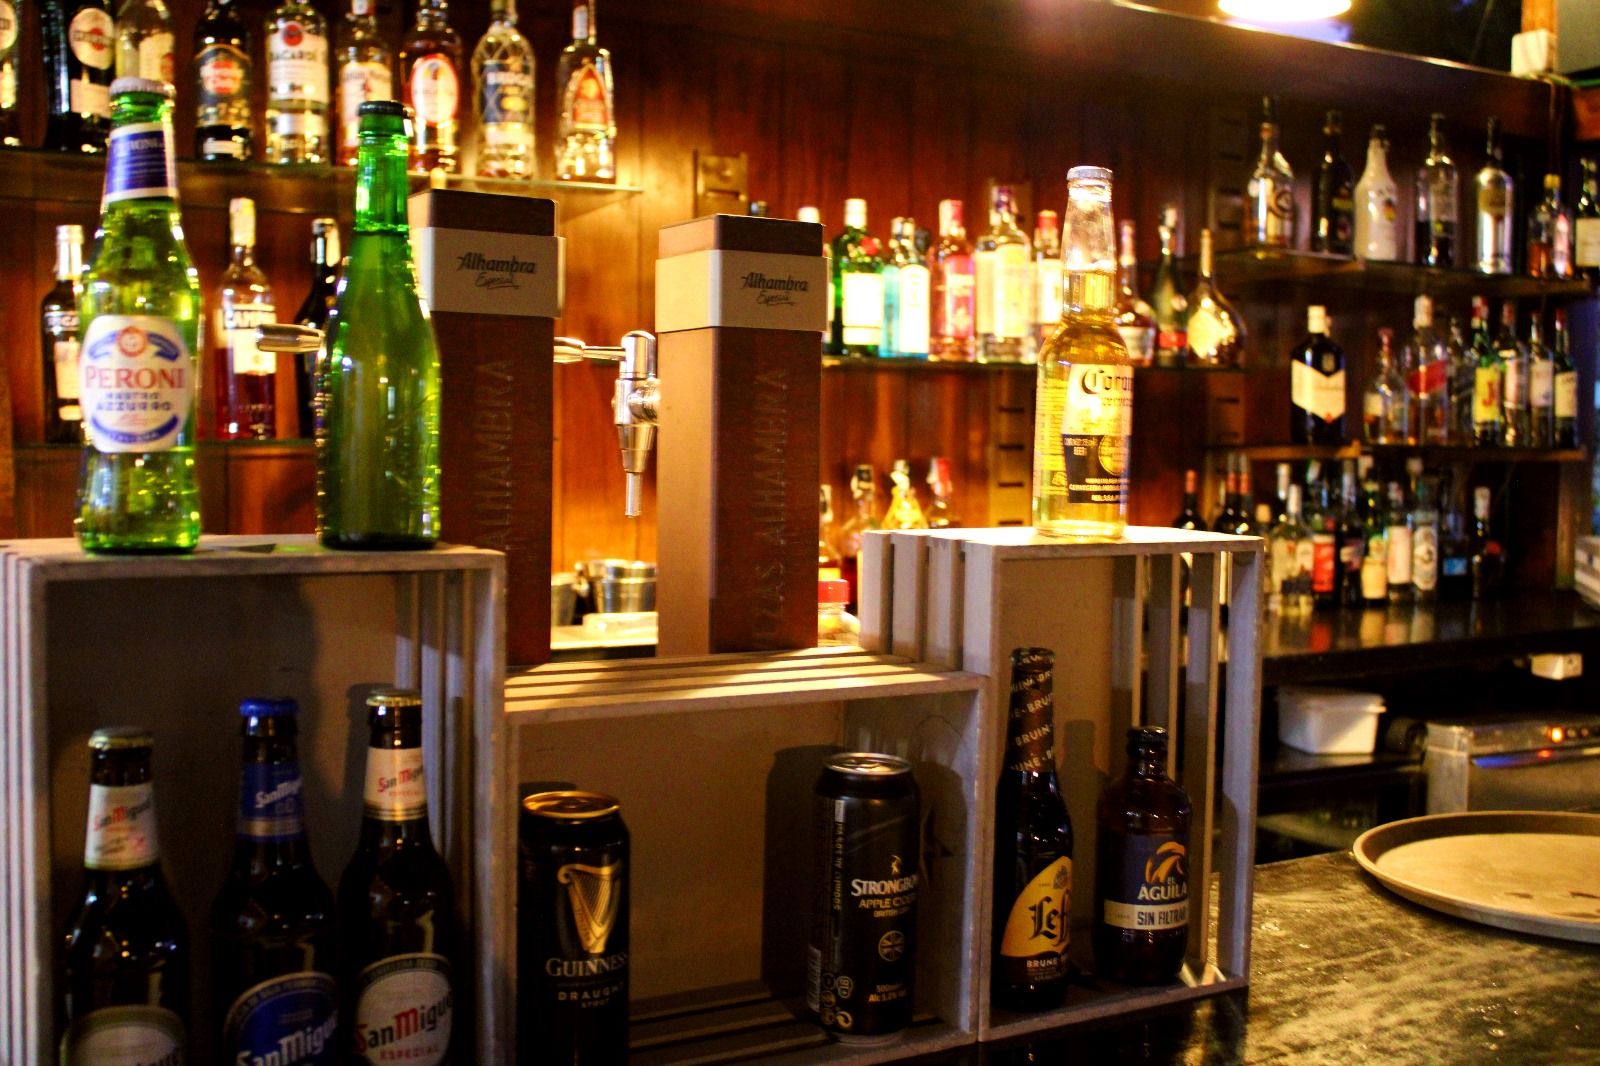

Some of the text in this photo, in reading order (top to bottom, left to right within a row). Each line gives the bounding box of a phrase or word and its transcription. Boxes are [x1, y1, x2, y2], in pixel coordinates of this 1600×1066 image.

[457, 251, 537, 275] Alhambra
[740, 272, 809, 292] Alhambra
[84, 366, 186, 389] PERONI
[96, 401, 172, 411] AZZURRO
[752, 368, 788, 547] ALHAMBRA
[1014, 724, 1051, 746] BRUIN
[858, 897, 891, 909] APPLE
[1137, 911, 1155, 926] SIN
[1027, 958, 1058, 969] BRUNE
[557, 981, 625, 1001] DRAUGHT
